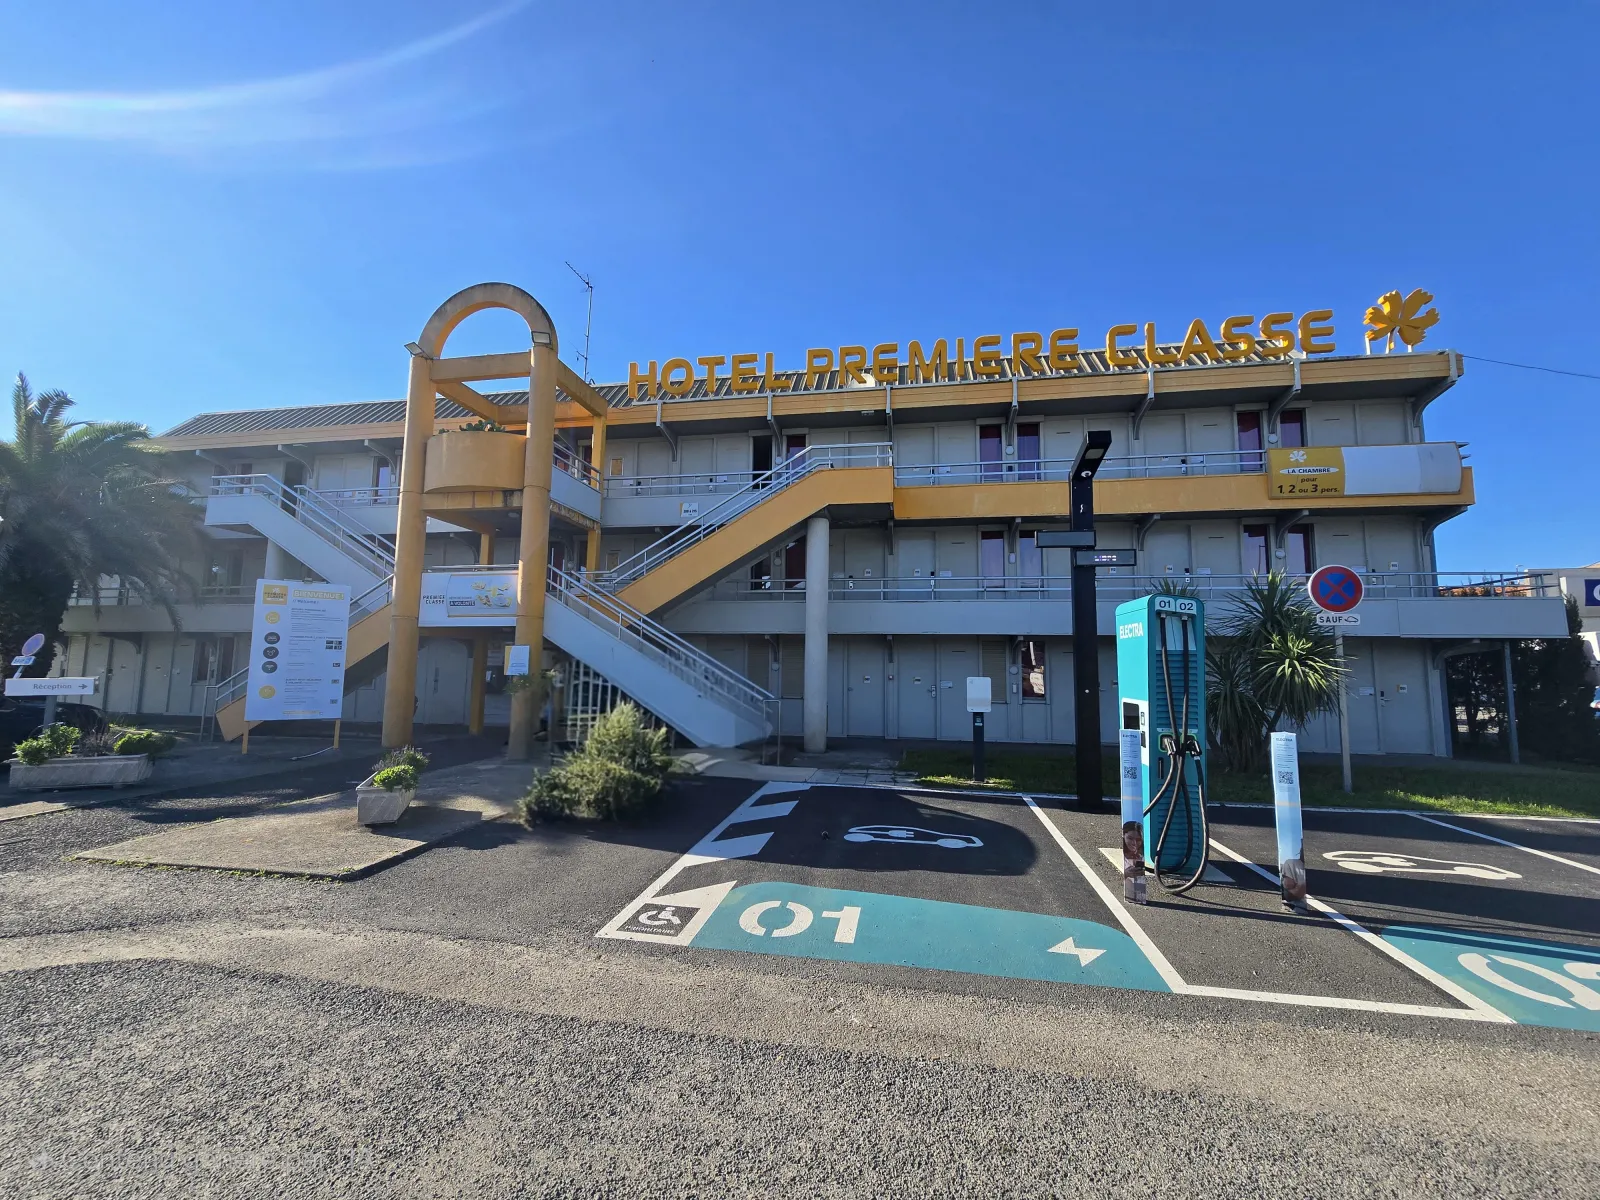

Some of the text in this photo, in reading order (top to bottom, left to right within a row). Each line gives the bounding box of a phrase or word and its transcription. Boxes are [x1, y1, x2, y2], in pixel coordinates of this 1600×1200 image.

[628, 309, 1336, 398] HOTEL PREMIERE CLASSE
[1288, 484, 1296, 494] 2
[1311, 484, 1319, 493] 3
[1159, 600, 1194, 611] 01 02
[1119, 622, 1144, 639] ELECTRA
[33, 683, 72, 691] Réception
[738, 900, 862, 944] 01
